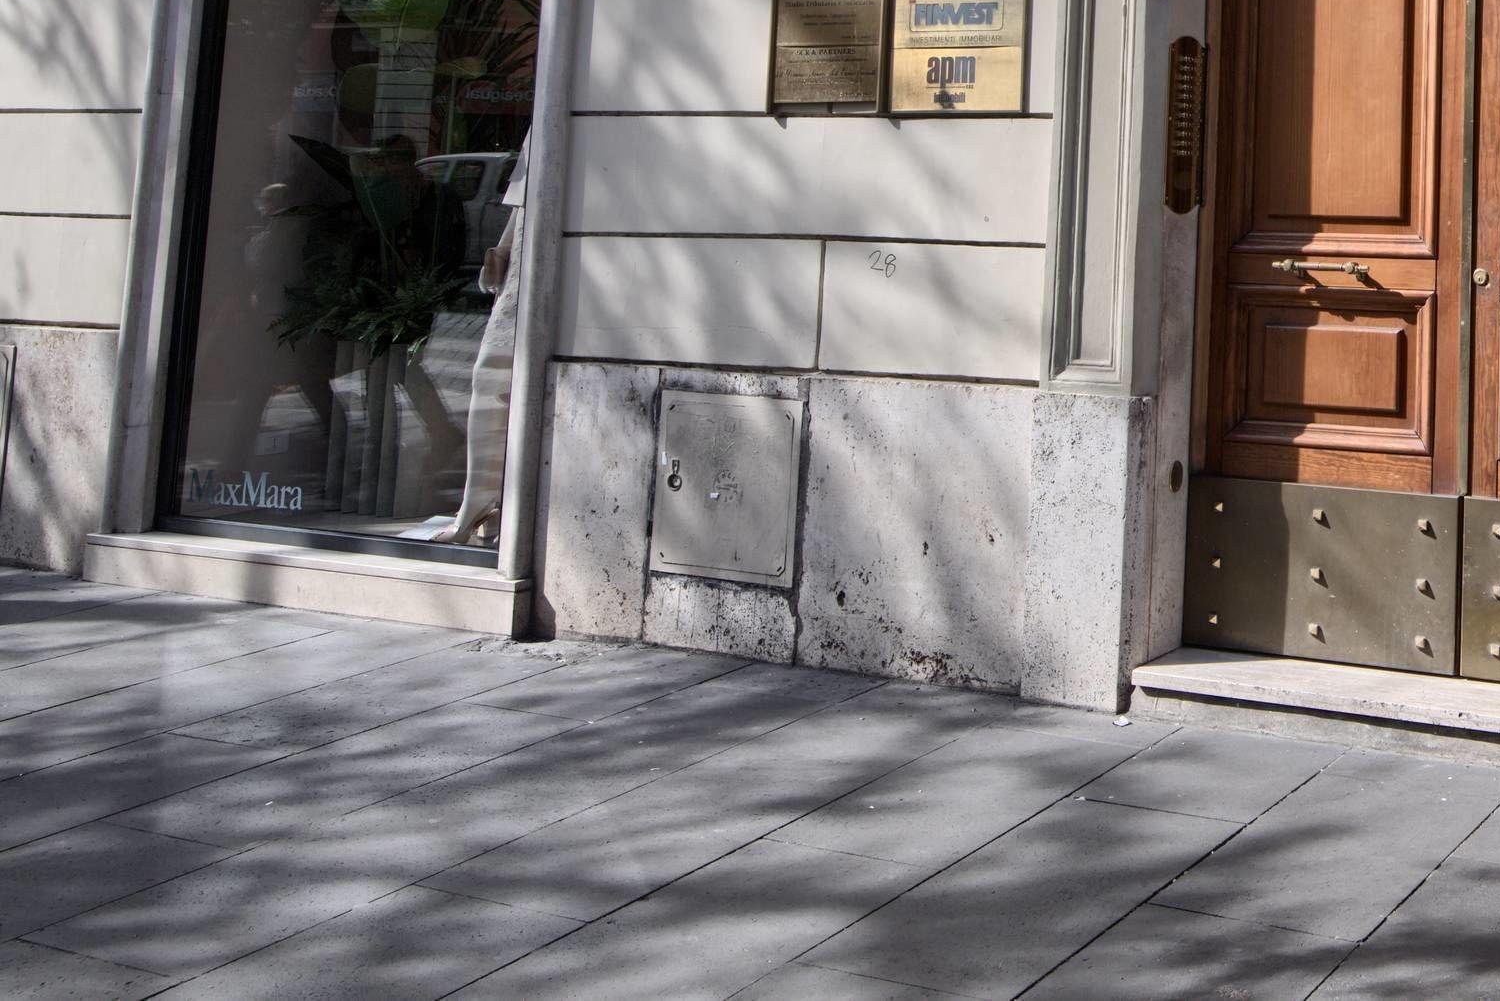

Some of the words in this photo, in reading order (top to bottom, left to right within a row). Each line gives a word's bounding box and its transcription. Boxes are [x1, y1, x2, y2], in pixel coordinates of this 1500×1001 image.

[914, 1, 998, 25] FINVEST
[926, 56, 976, 89] apm
[869, 250, 897, 278] 28
[186, 468, 303, 511] MaxMara
